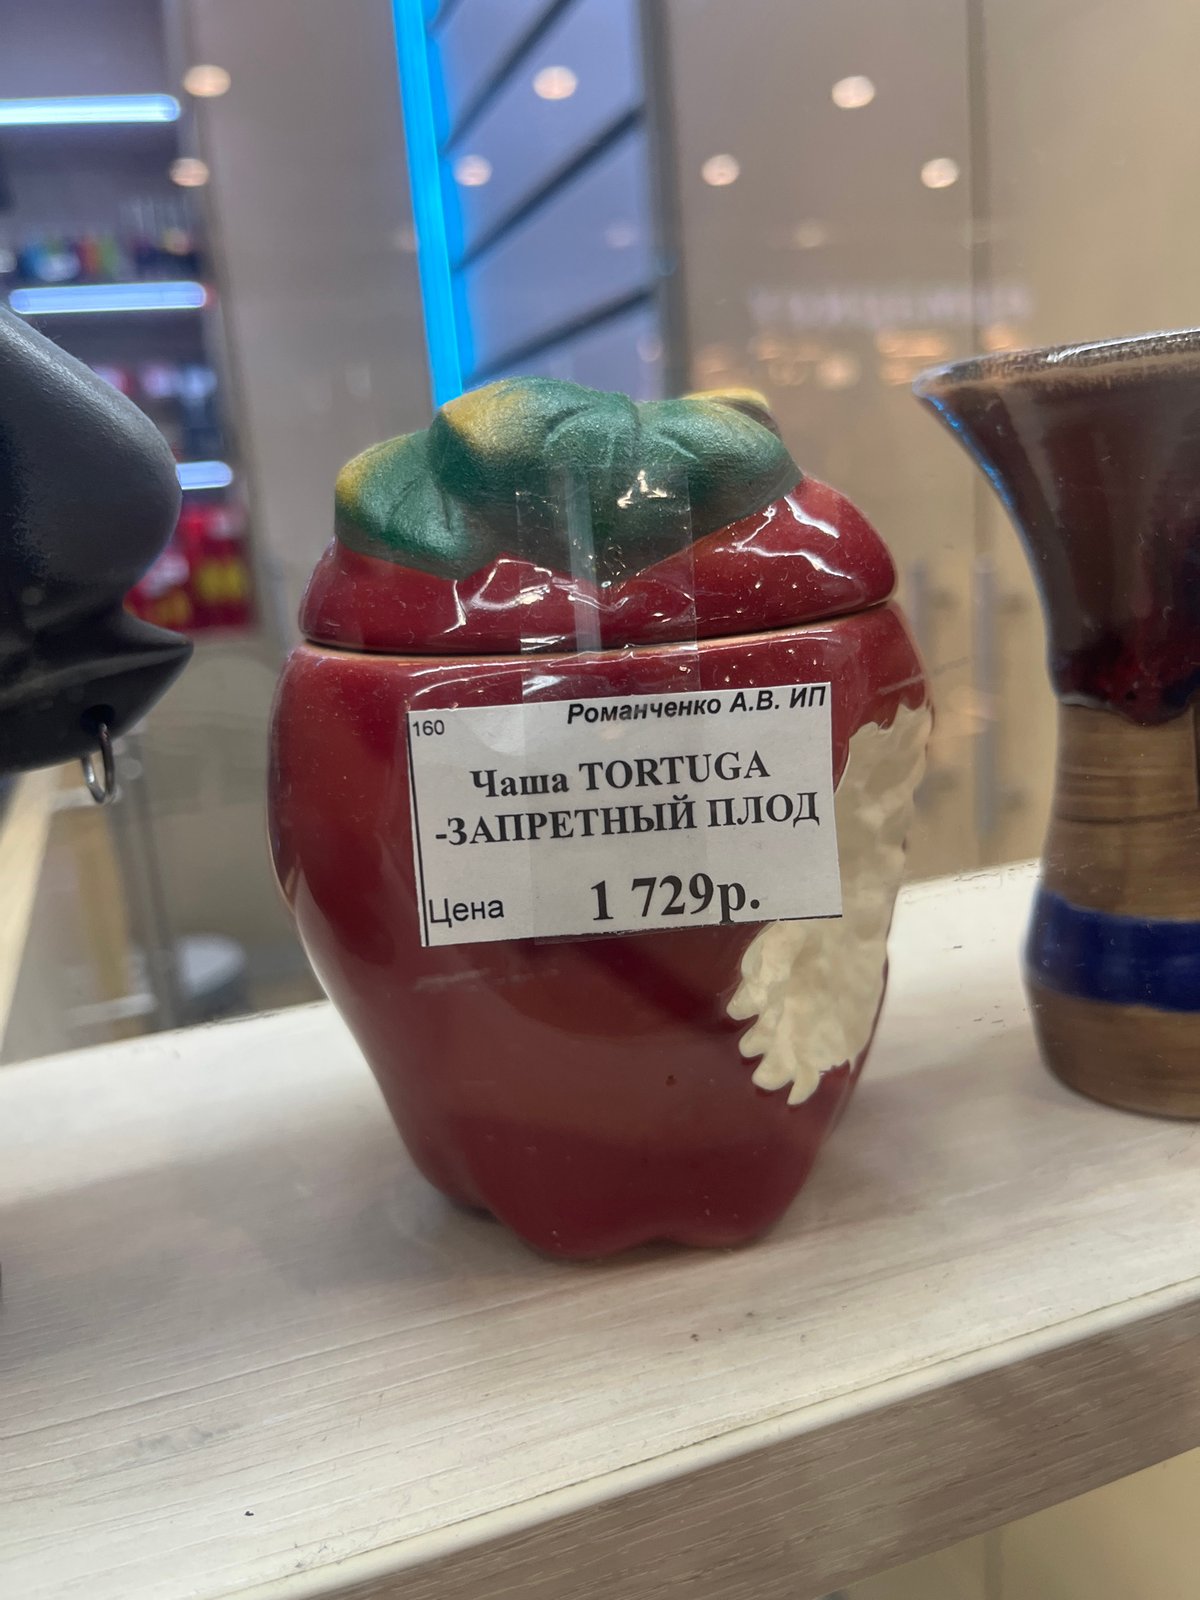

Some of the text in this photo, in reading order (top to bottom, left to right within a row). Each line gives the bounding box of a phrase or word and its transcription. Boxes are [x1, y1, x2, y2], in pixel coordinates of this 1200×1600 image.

[412, 720, 446, 737] 160
[566, 686, 827, 725] Романченко А.В. ИП
[470, 750, 771, 798] Чаша TORTUGA
[435, 791, 820, 846] -ЗАПРЕТНЫЙ ПЛОД
[429, 872, 761, 929] Цена 1 729р.
